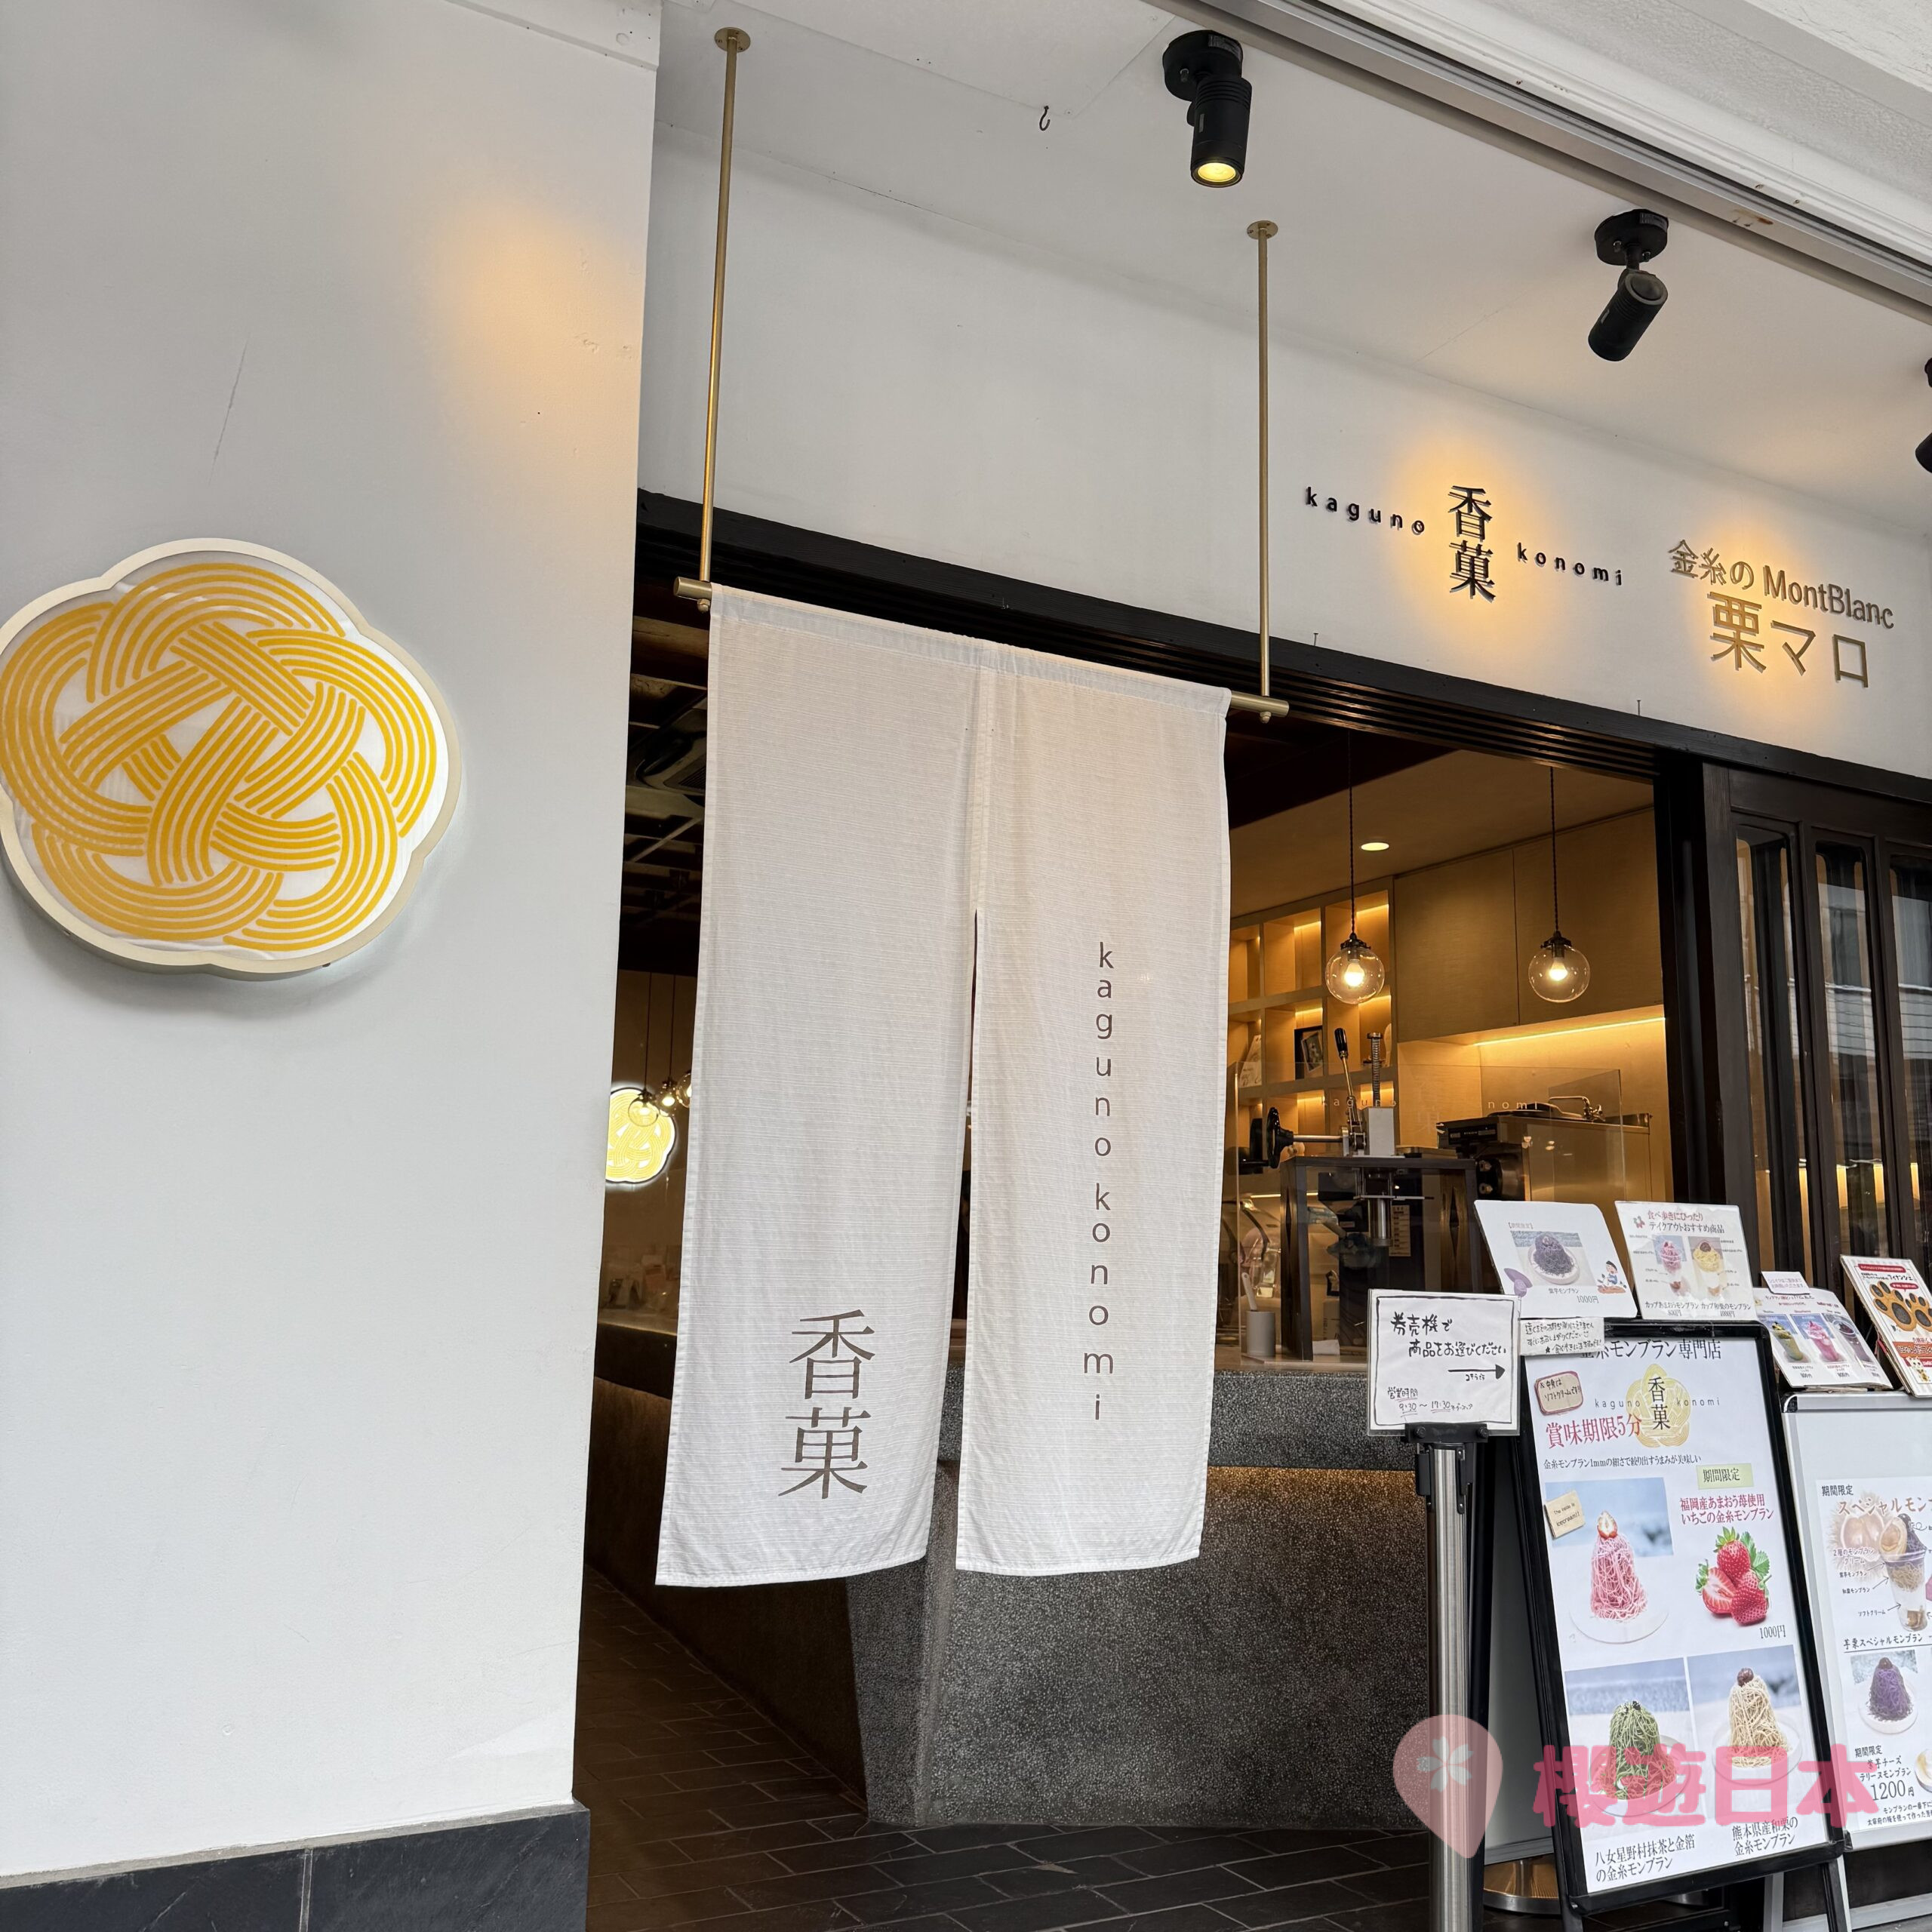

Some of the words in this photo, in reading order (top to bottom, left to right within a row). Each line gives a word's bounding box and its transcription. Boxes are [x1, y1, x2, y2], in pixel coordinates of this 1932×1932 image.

[1305, 486, 1426, 535] kaguno
[1448, 485, 1496, 601] 香菓
[1516, 542, 1623, 586] konomi
[1707, 591, 1869, 688] 栗マロ
[1649, 1223, 1725, 1234] テイクアウトおすすめ商品
[1577, 1295, 1599, 1304] 1000円
[1390, 1311, 1453, 1337] 券売機で
[1408, 1339, 1506, 1358] 商品をお選びください
[778, 1309, 875, 1500] 香菓
[1595, 1398, 1641, 1410] kaguno
[1676, 1397, 1720, 1407] konomi
[1647, 1376, 1671, 1430] 香菓
[1546, 1413, 1642, 1449] 賞味期限5分
[1703, 1467, 1740, 1483] 期間限定
[1680, 1493, 1765, 1511] 福岡産あまおう苺使用
[1821, 1484, 1854, 1497] 期間限定
[1681, 1509, 1774, 1525] いちごの金糸モンブラン
[1760, 1625, 1786, 1639] 1000円
[1854, 1744, 1883, 1758] 期間限定
[1732, 1816, 1798, 1841] 熊本県産和栗の
[1595, 1834, 1695, 1866] 八女星野村抹茶と金箔
[1735, 1832, 1795, 1857] 金糸モンブラン
[1596, 1857, 1673, 1883] の金糸モンブラン
